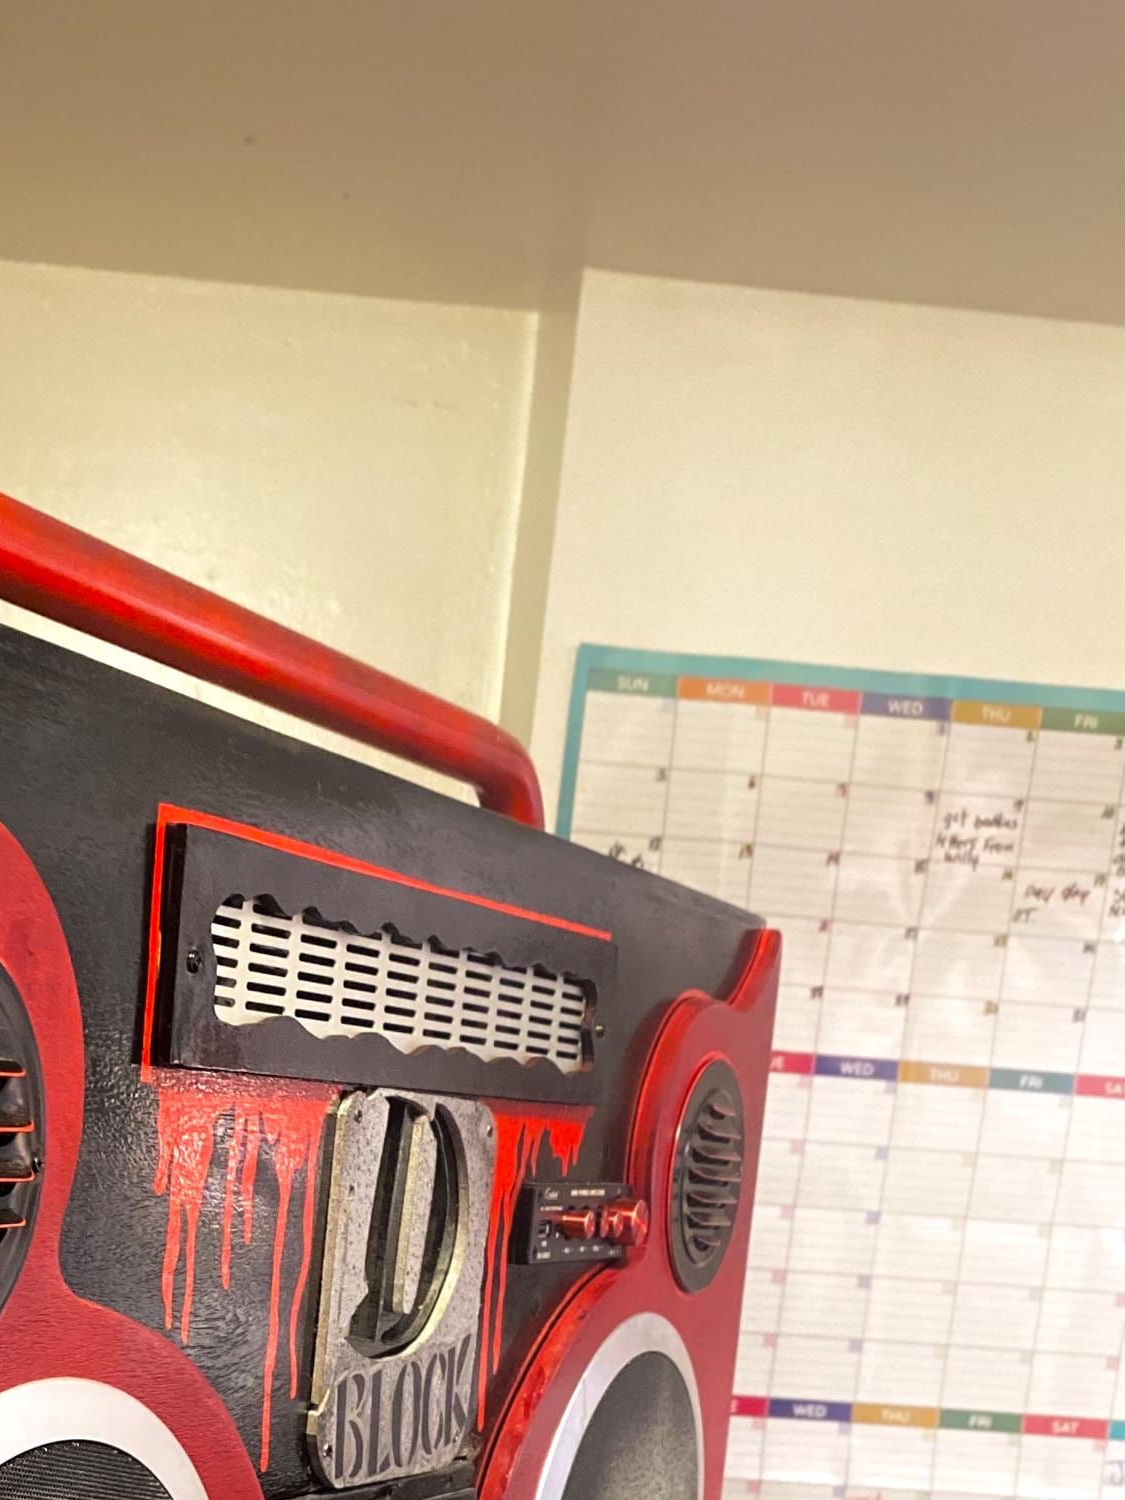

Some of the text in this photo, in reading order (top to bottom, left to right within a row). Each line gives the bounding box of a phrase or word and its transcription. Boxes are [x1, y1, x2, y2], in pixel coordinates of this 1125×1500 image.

[616, 675, 1098, 730] SUN MON TUE WED THU FRI
[839, 1060, 874, 1077] WED
[929, 1067, 960, 1083] THU
[1019, 1076, 1043, 1090] FRI
[334, 1334, 472, 1481] BLOCK
[792, 1403, 1080, 1435] WED THU FRI SAT
